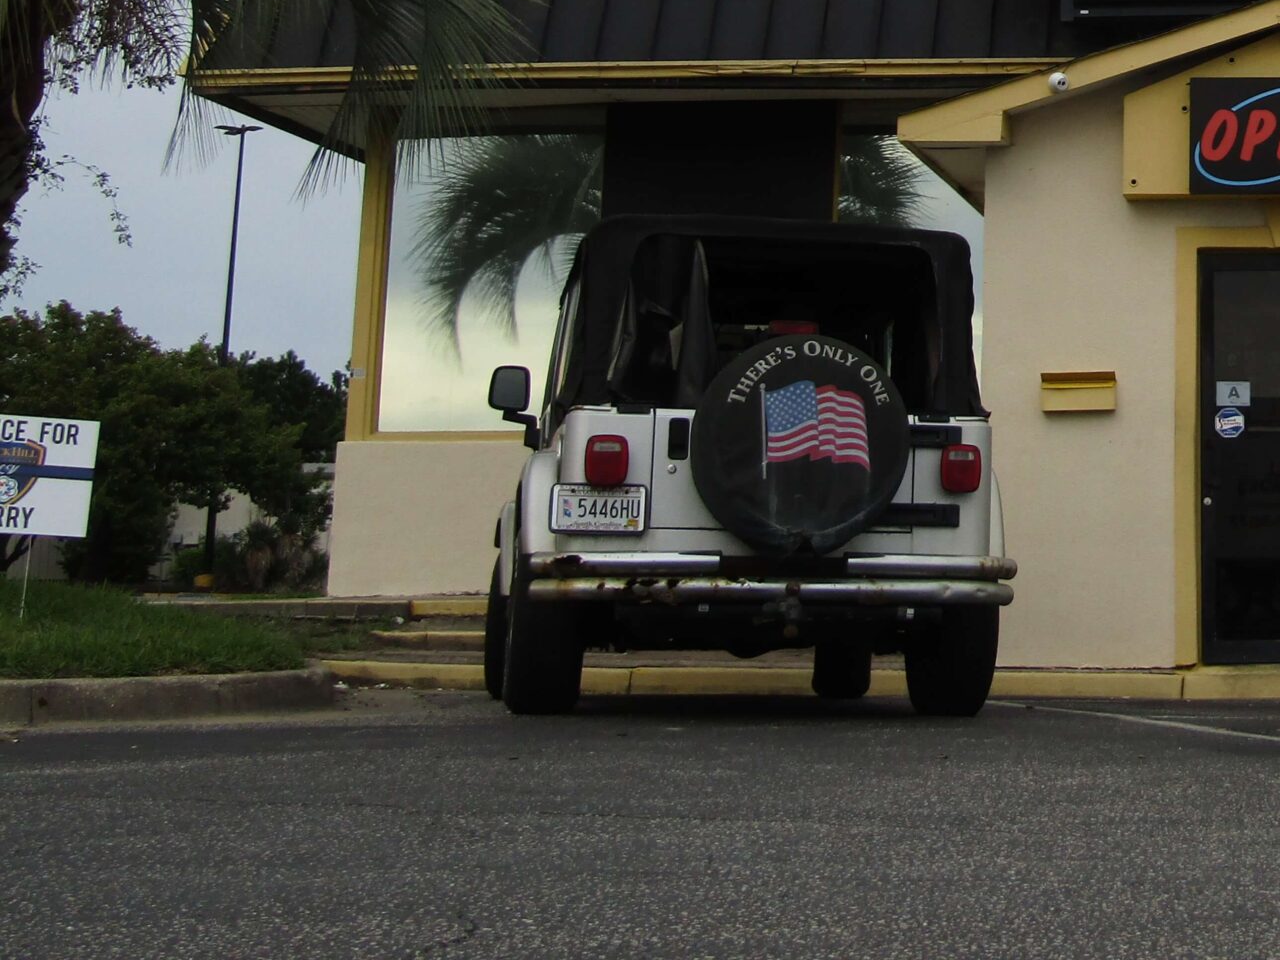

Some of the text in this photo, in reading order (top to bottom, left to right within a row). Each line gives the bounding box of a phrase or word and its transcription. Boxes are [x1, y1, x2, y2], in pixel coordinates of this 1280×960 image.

[1228, 386, 1240, 399] A
[0, 419, 79, 445] CE FOR
[577, 498, 641, 519] 5446HU
